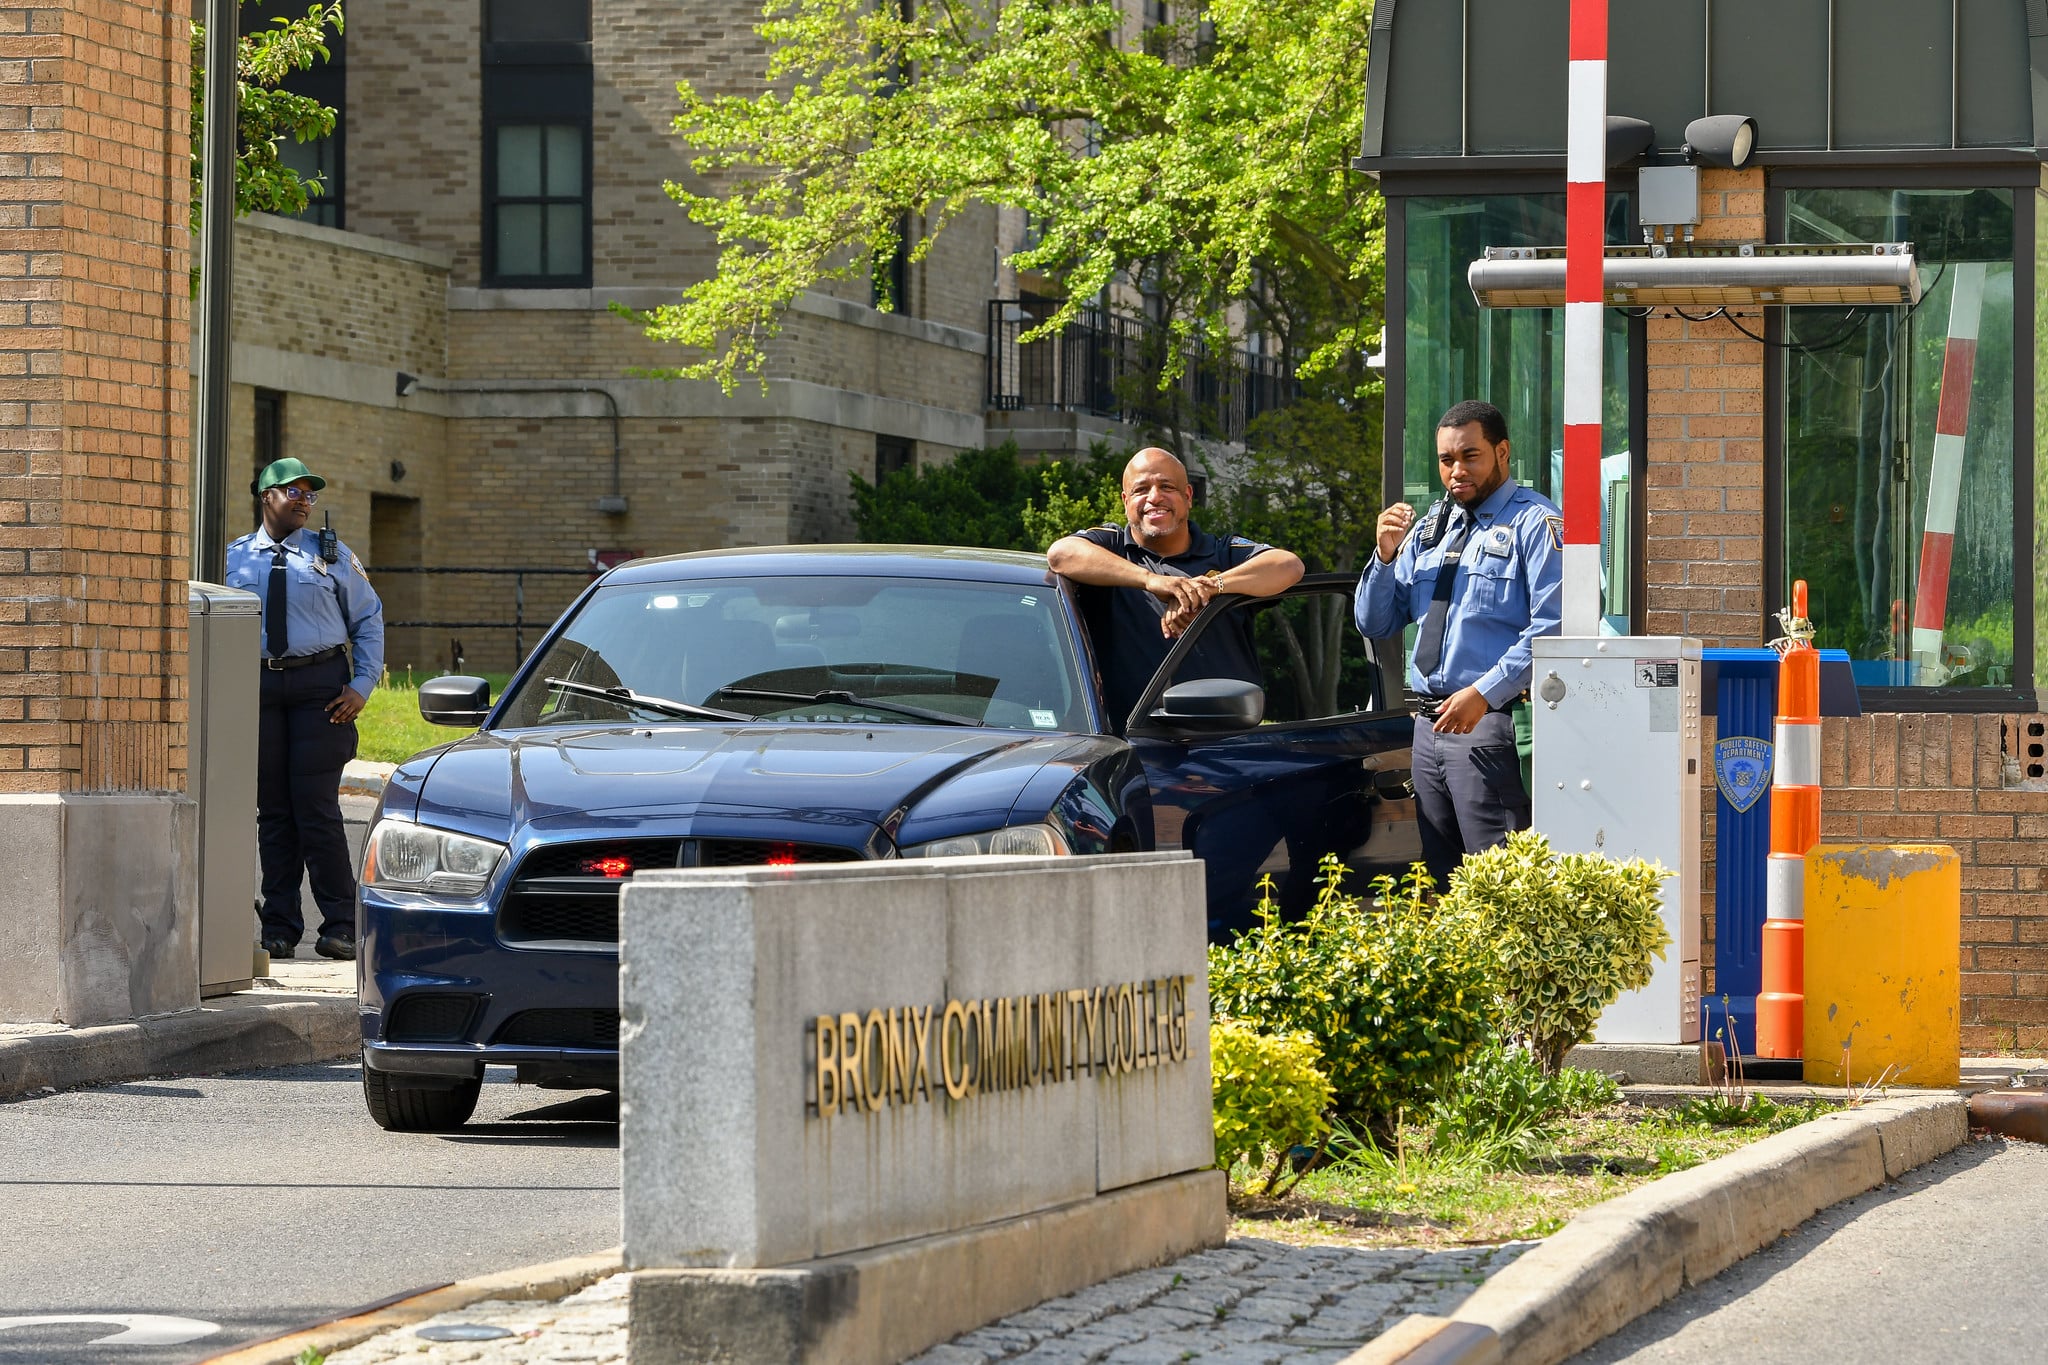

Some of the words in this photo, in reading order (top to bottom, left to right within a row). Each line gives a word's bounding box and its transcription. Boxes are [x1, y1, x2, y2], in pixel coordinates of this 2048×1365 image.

[1720, 740, 1742, 751] PUBLIC
[1744, 740, 1768, 752] SAFETY
[1722, 748, 1765, 760] DEPARTMENT
[1719, 774, 1741, 804] UNIVERSITY
[1749, 787, 1760, 799] NEW
[1760, 769, 1769, 784] YORK
[815, 1004, 933, 1118] BRONX
[941, 986, 1101, 1099] COMMUNITY
[1103, 974, 1196, 1077] COLLEGE
